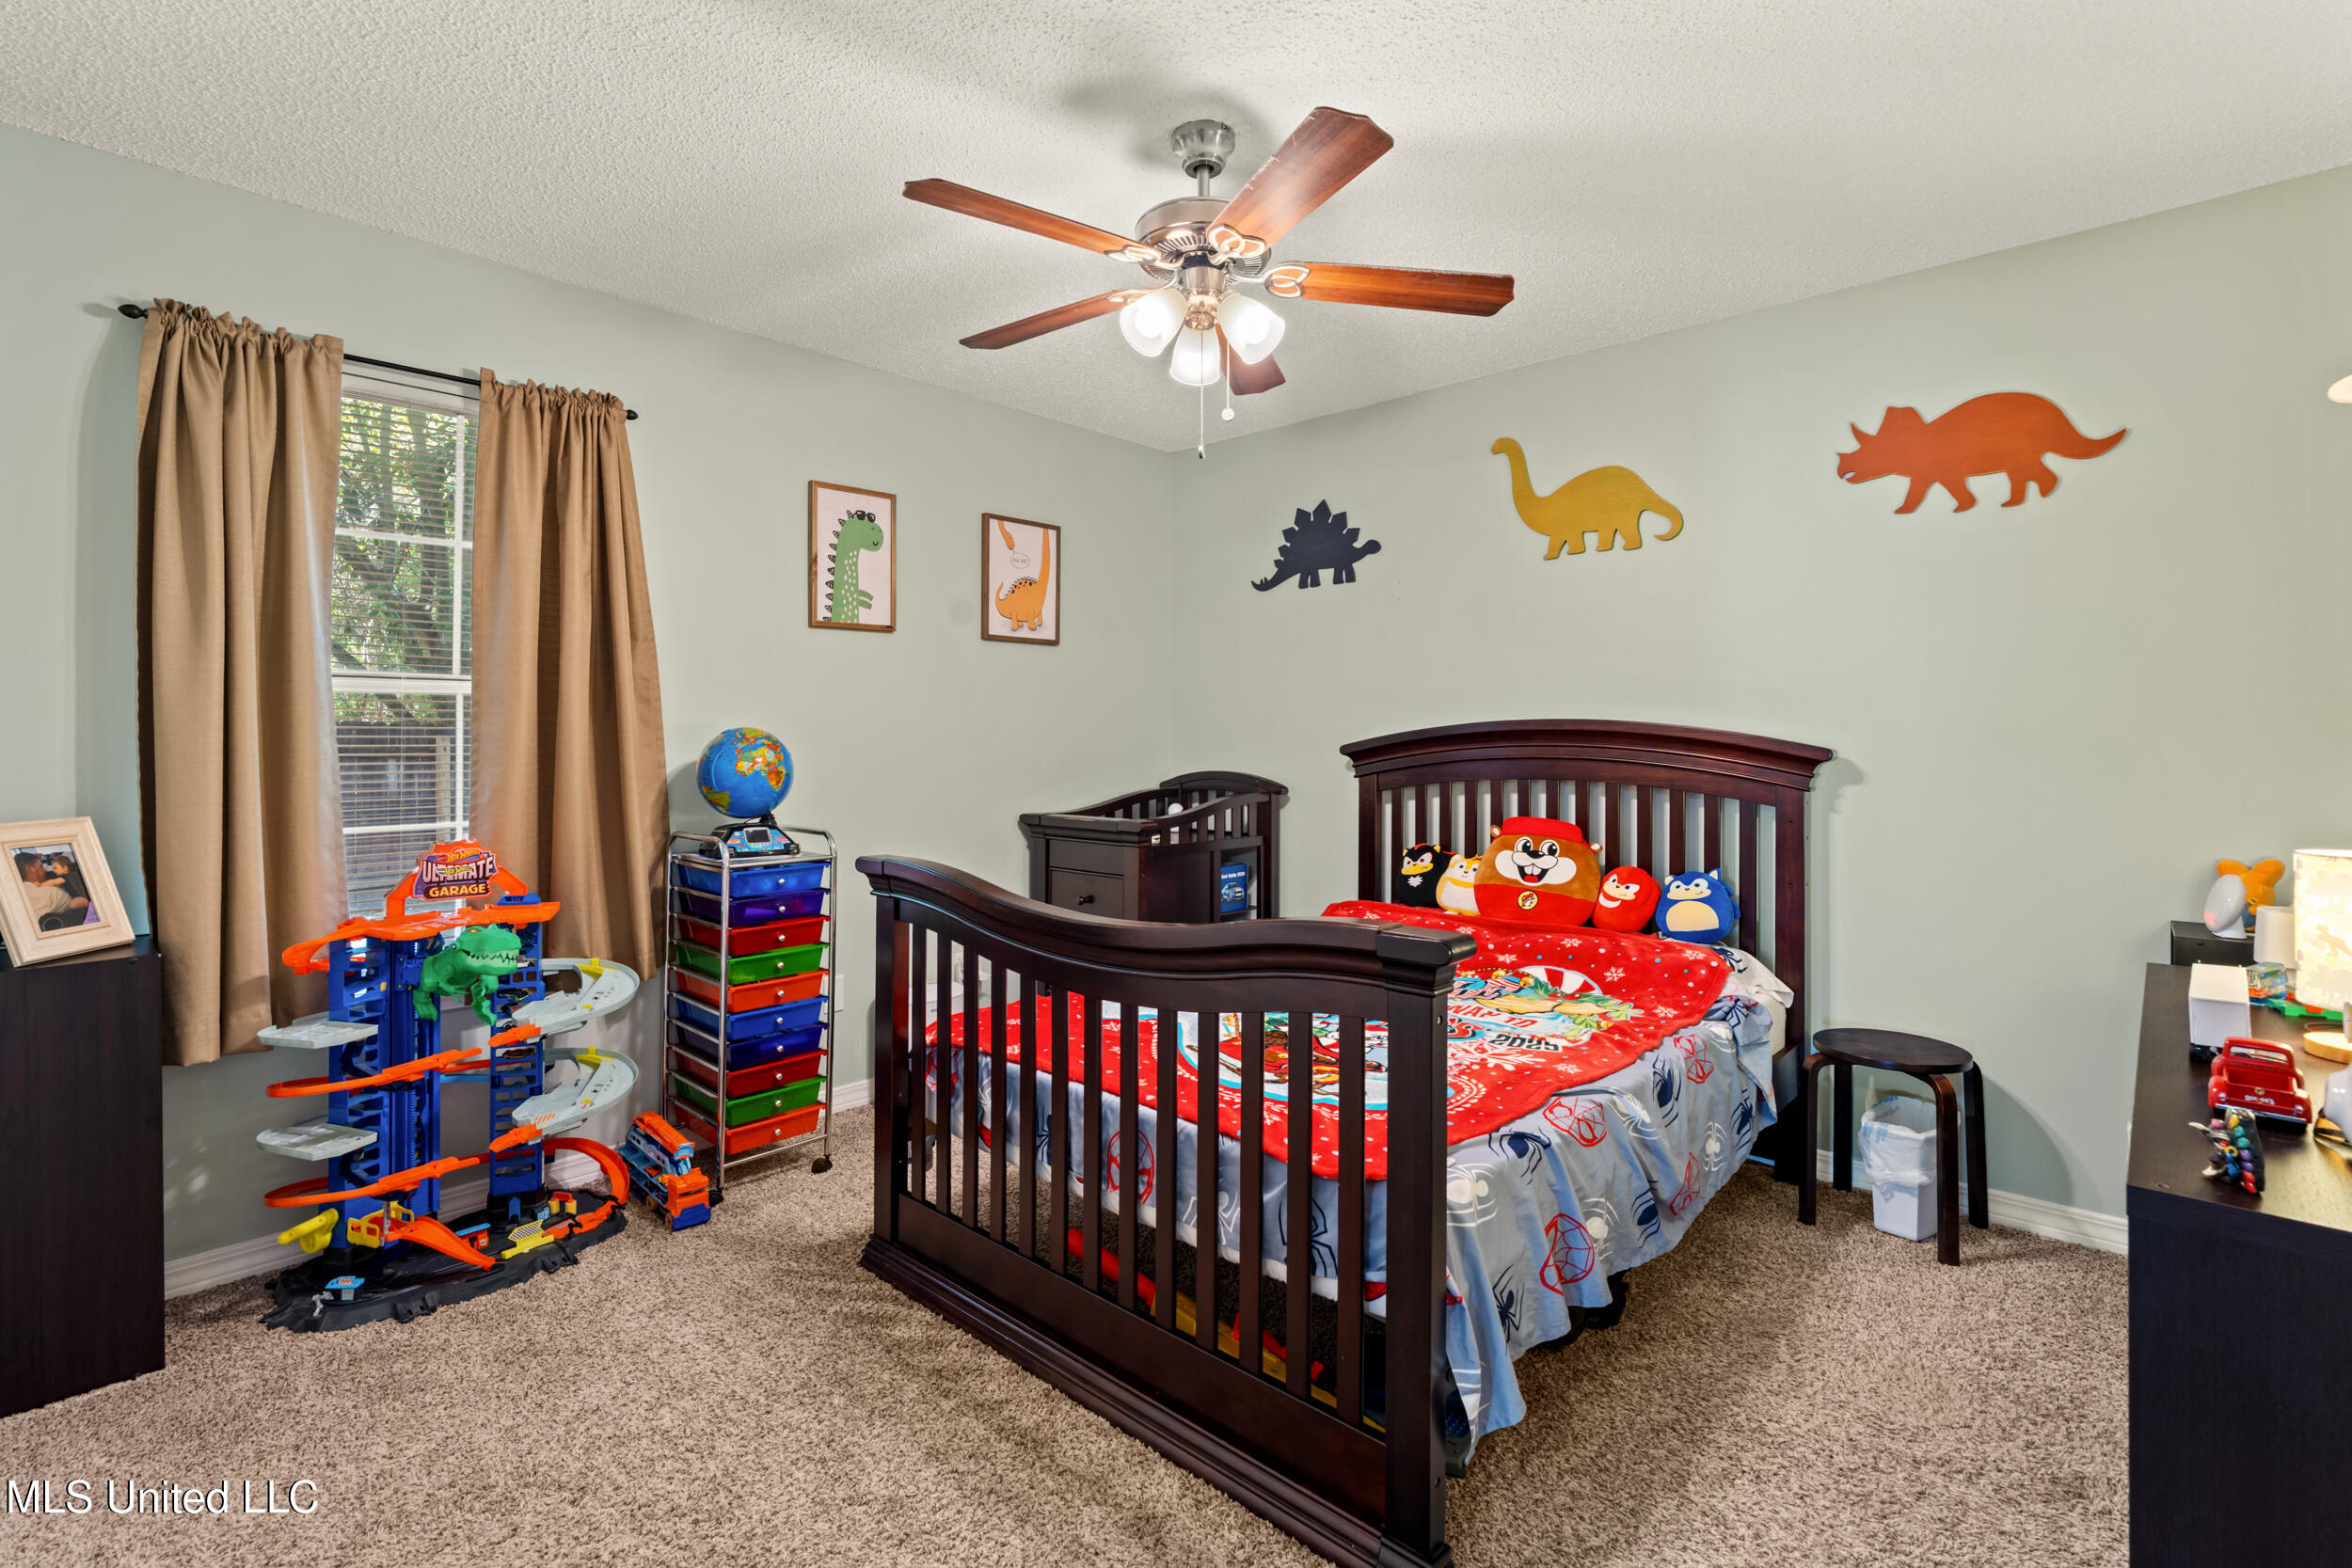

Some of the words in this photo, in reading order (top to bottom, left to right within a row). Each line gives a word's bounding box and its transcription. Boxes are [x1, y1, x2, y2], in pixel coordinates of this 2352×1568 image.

[429, 883, 486, 897] GARAGE
[1504, 1016, 1538, 1028] TO
[1488, 1034, 1561, 1052] 2025
